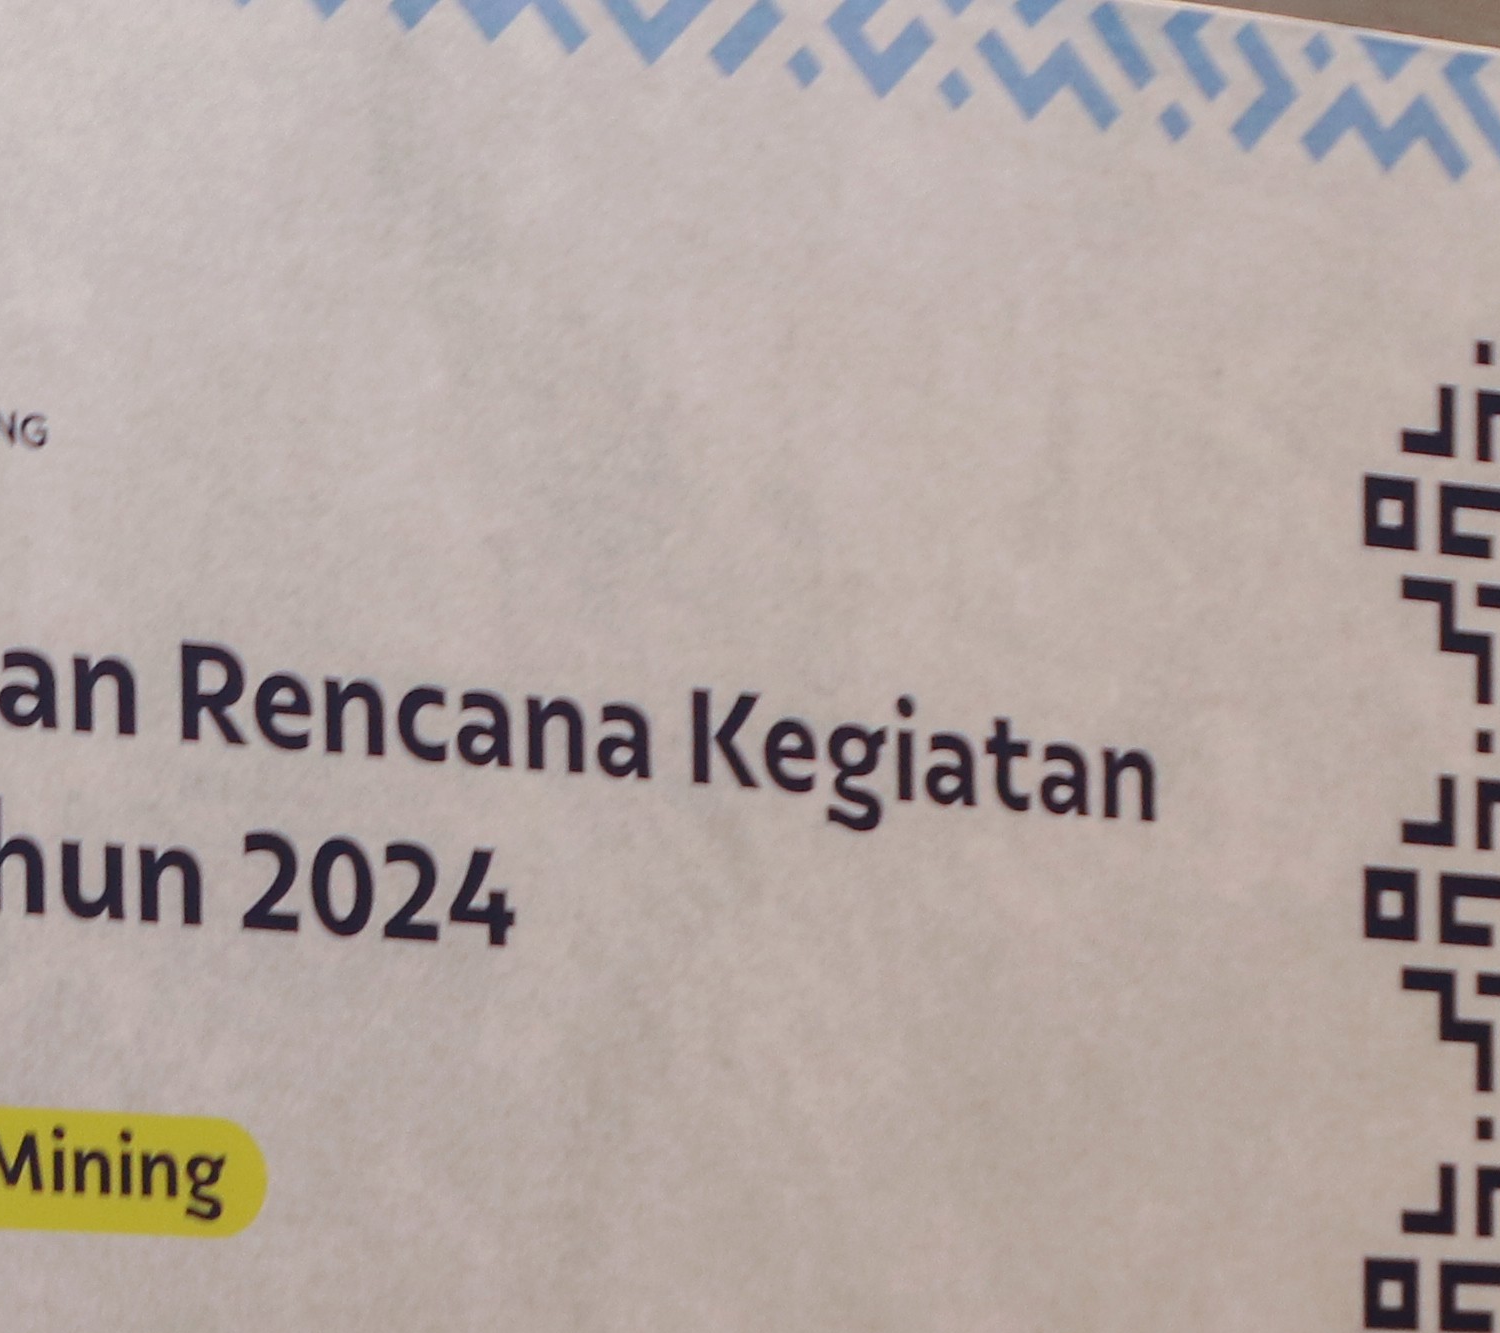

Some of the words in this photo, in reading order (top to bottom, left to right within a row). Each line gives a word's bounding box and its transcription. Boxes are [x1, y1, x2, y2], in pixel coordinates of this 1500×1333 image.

[178, 642, 651, 779] Rencana
[690, 686, 1160, 830] Kegiatan
[241, 830, 516, 946] 2024
